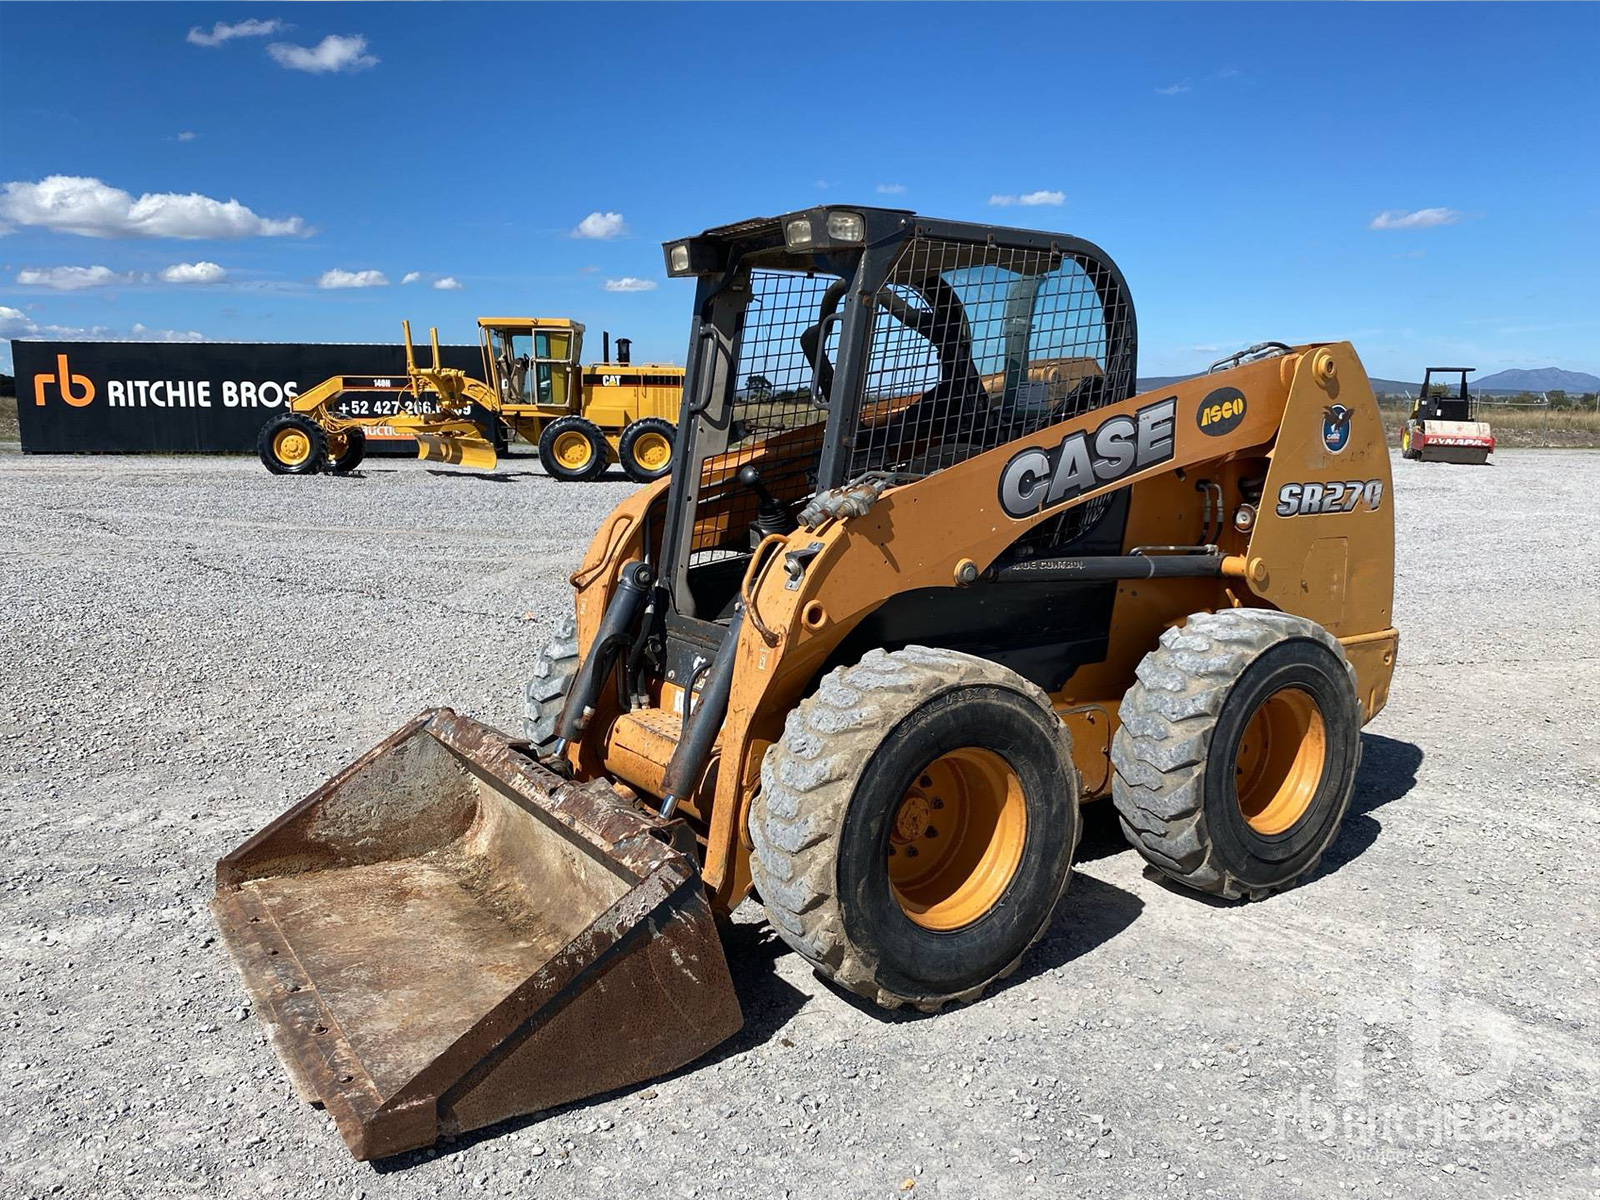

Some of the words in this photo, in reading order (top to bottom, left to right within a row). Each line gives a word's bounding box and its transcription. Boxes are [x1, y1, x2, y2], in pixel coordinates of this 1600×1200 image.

[34, 354, 95, 407] rb
[107, 380, 211, 408] RITCHIE
[222, 381, 299, 408] BROS
[373, 379, 391, 388] 140H
[602, 375, 621, 387] CAT
[373, 401, 399, 414] 427
[1000, 398, 1176, 517] CASE
[895, 687, 1000, 737] GALAXY
